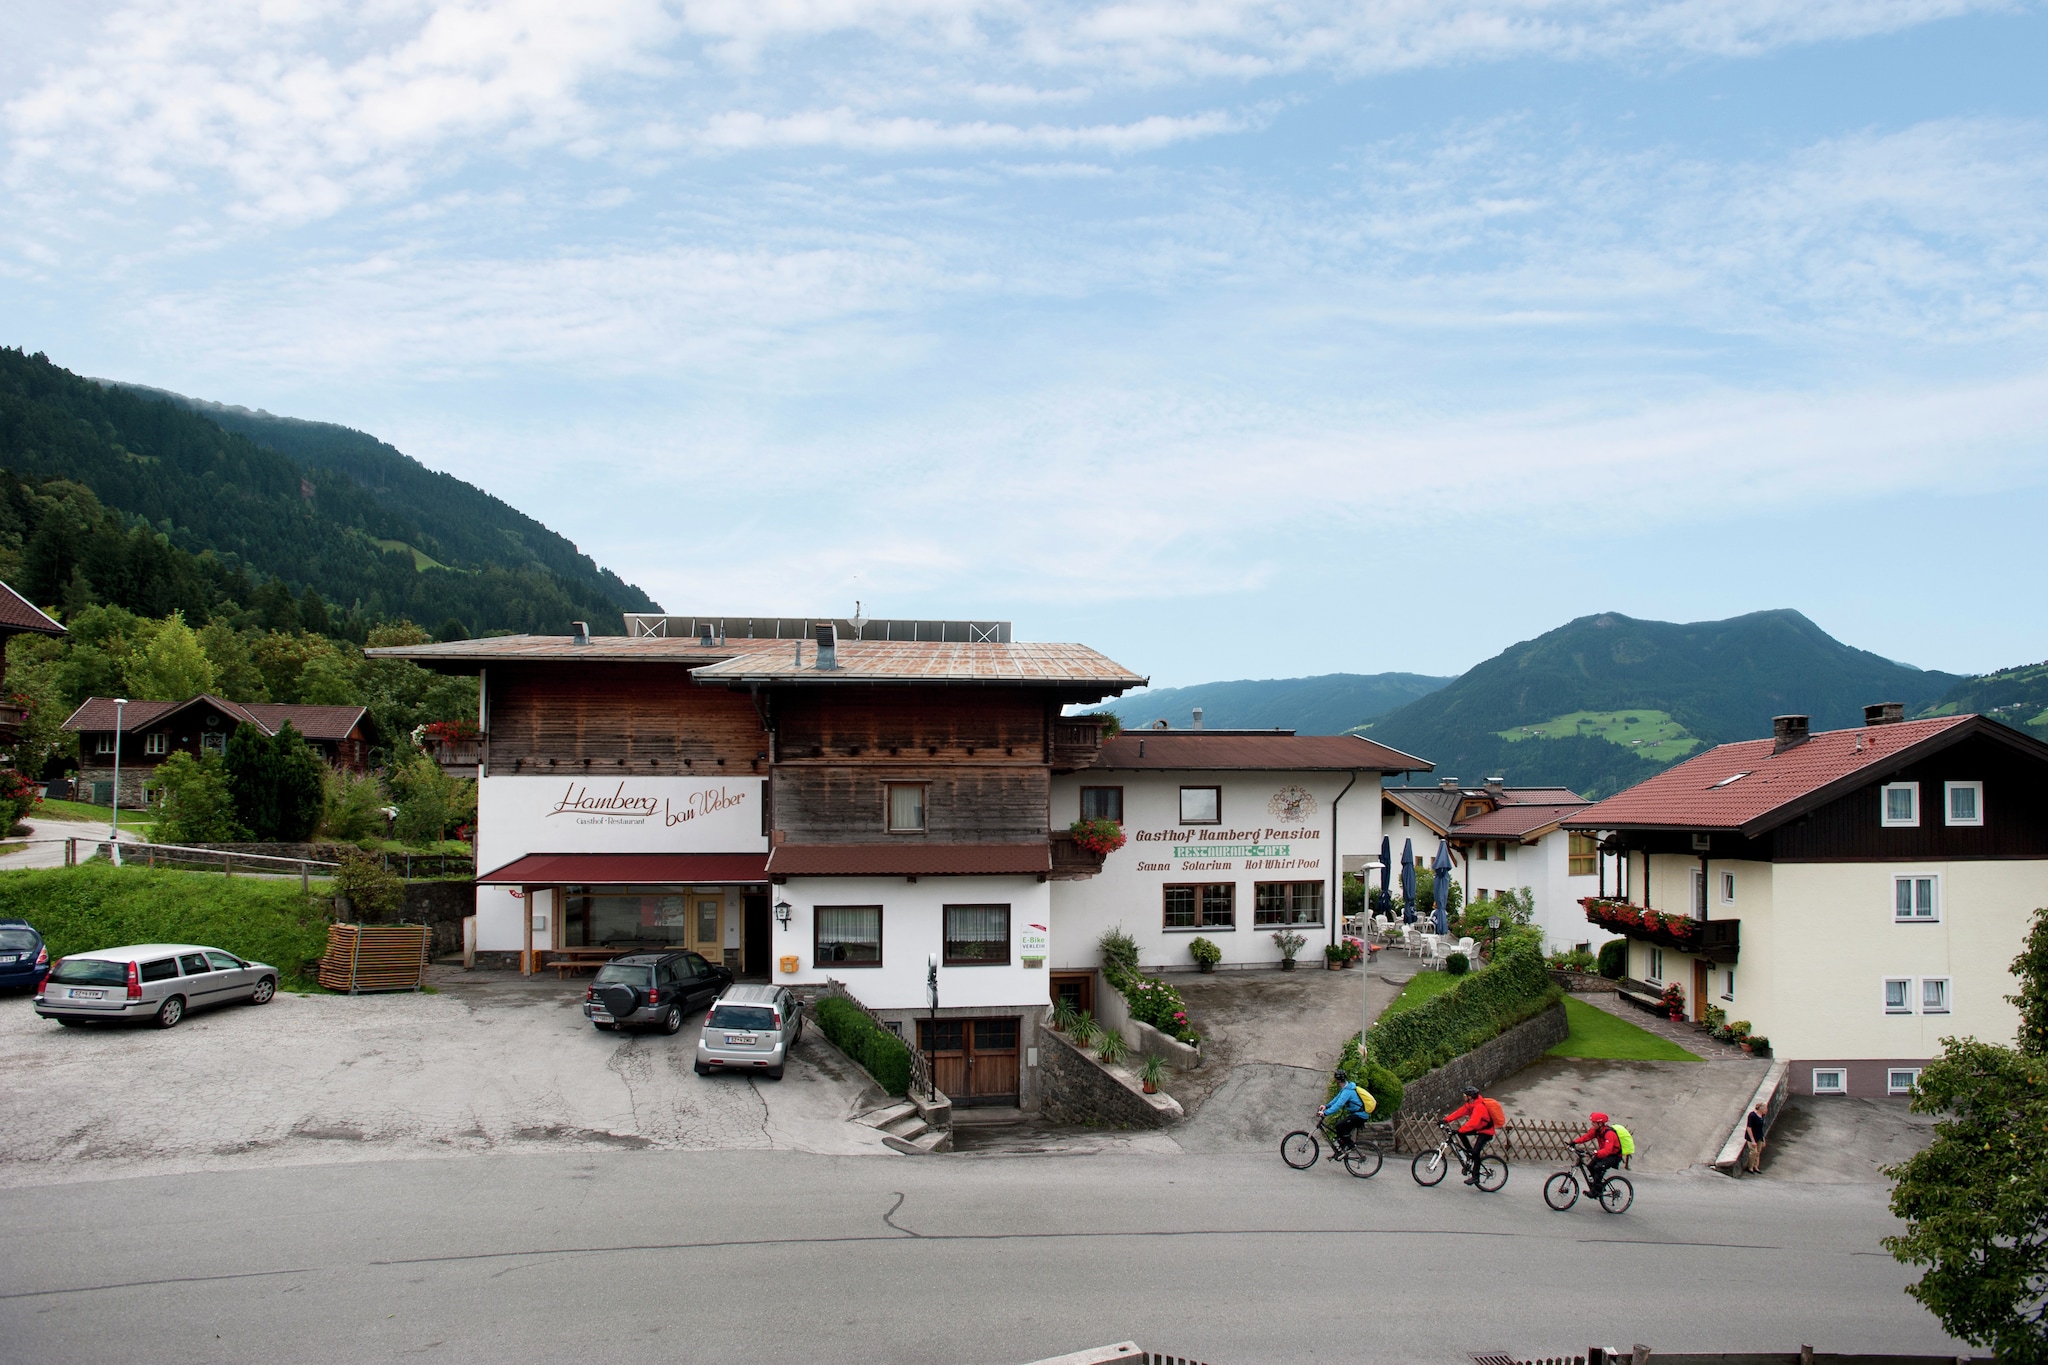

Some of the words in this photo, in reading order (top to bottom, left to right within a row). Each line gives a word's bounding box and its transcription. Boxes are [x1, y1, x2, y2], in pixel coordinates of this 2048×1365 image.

[553, 781, 658, 816] Hamberg
[689, 786, 746, 816] Weber
[1136, 829, 1196, 843] Gasthof
[1198, 829, 1261, 844] Hamberg
[1264, 827, 1320, 840] Pension
[1136, 861, 1171, 871] Sauna
[1181, 860, 1232, 871] Solarium
[1297, 859, 1320, 869] Pool
